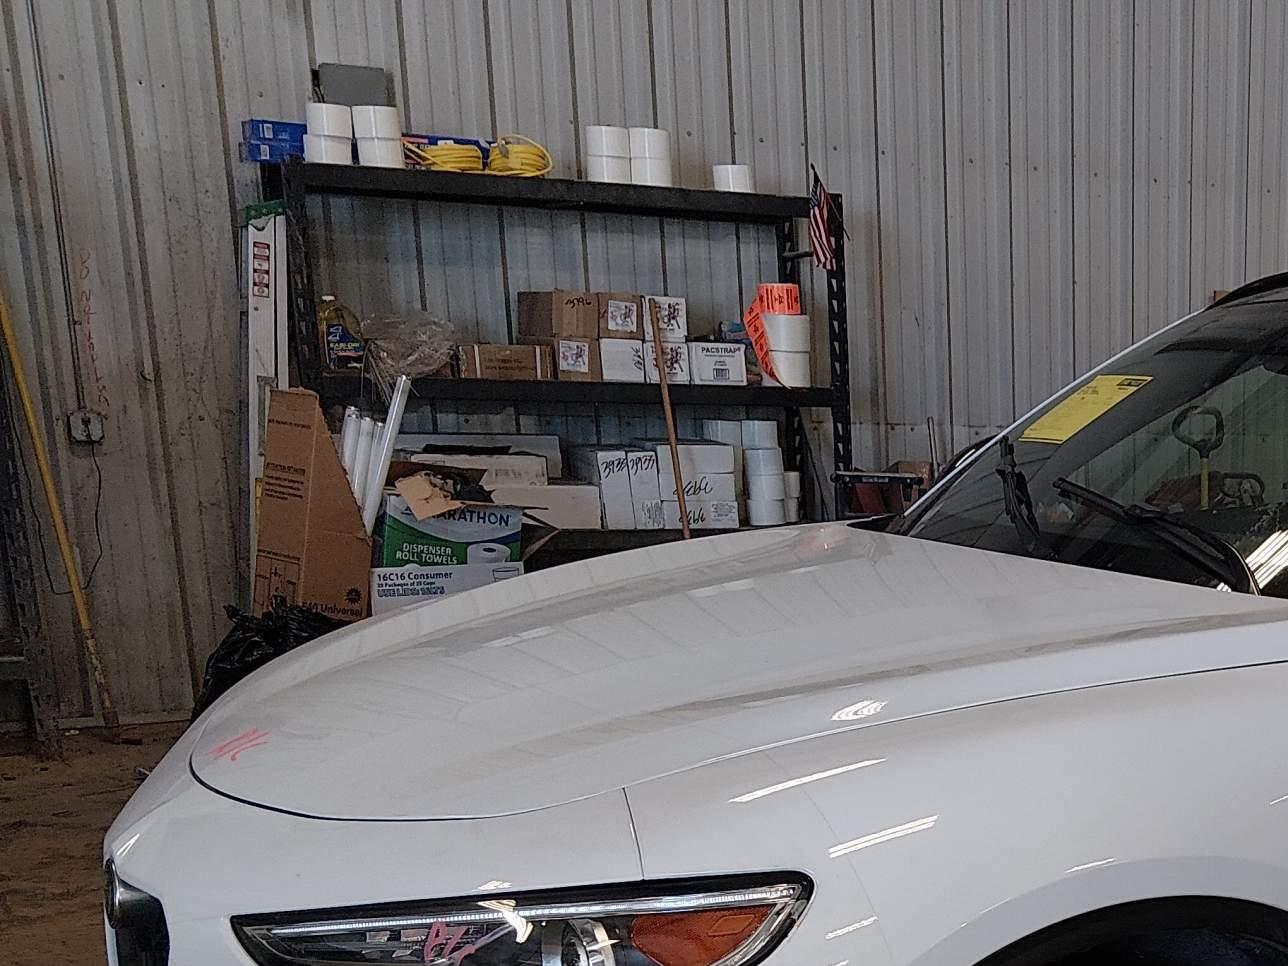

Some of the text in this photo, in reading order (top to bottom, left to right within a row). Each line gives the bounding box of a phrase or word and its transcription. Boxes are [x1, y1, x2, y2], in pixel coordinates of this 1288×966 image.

[431, 507, 511, 527] ARATHON
[402, 543, 452, 556] DISPENSER
[395, 550, 458, 564] ROLL TOWELS
[377, 572, 453, 582] 16C16 Consumer
[320, 603, 363, 617] Universal
